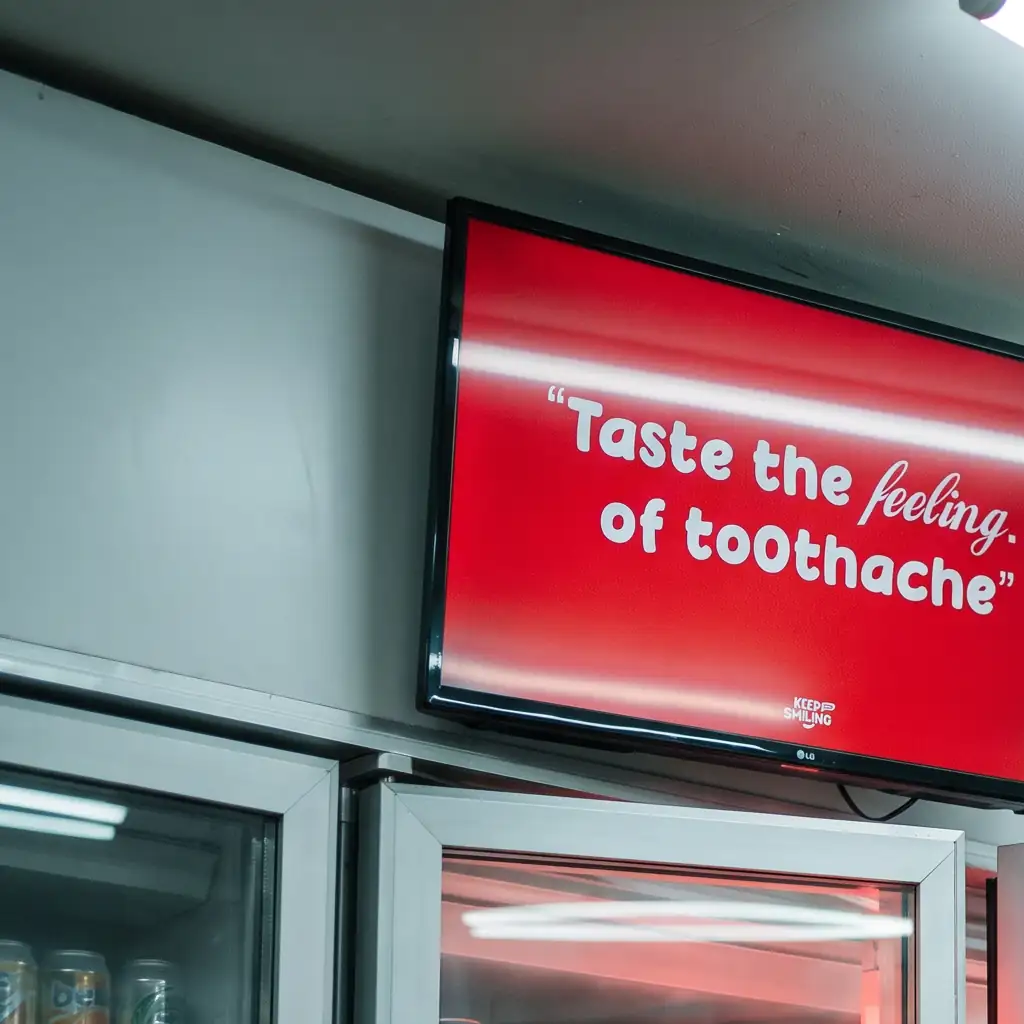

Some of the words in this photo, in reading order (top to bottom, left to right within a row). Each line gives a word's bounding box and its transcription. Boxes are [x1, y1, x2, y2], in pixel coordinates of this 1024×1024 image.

[753, 439, 853, 506] the
[600, 498, 666, 554] of
[783, 707, 832, 726] SMILING
